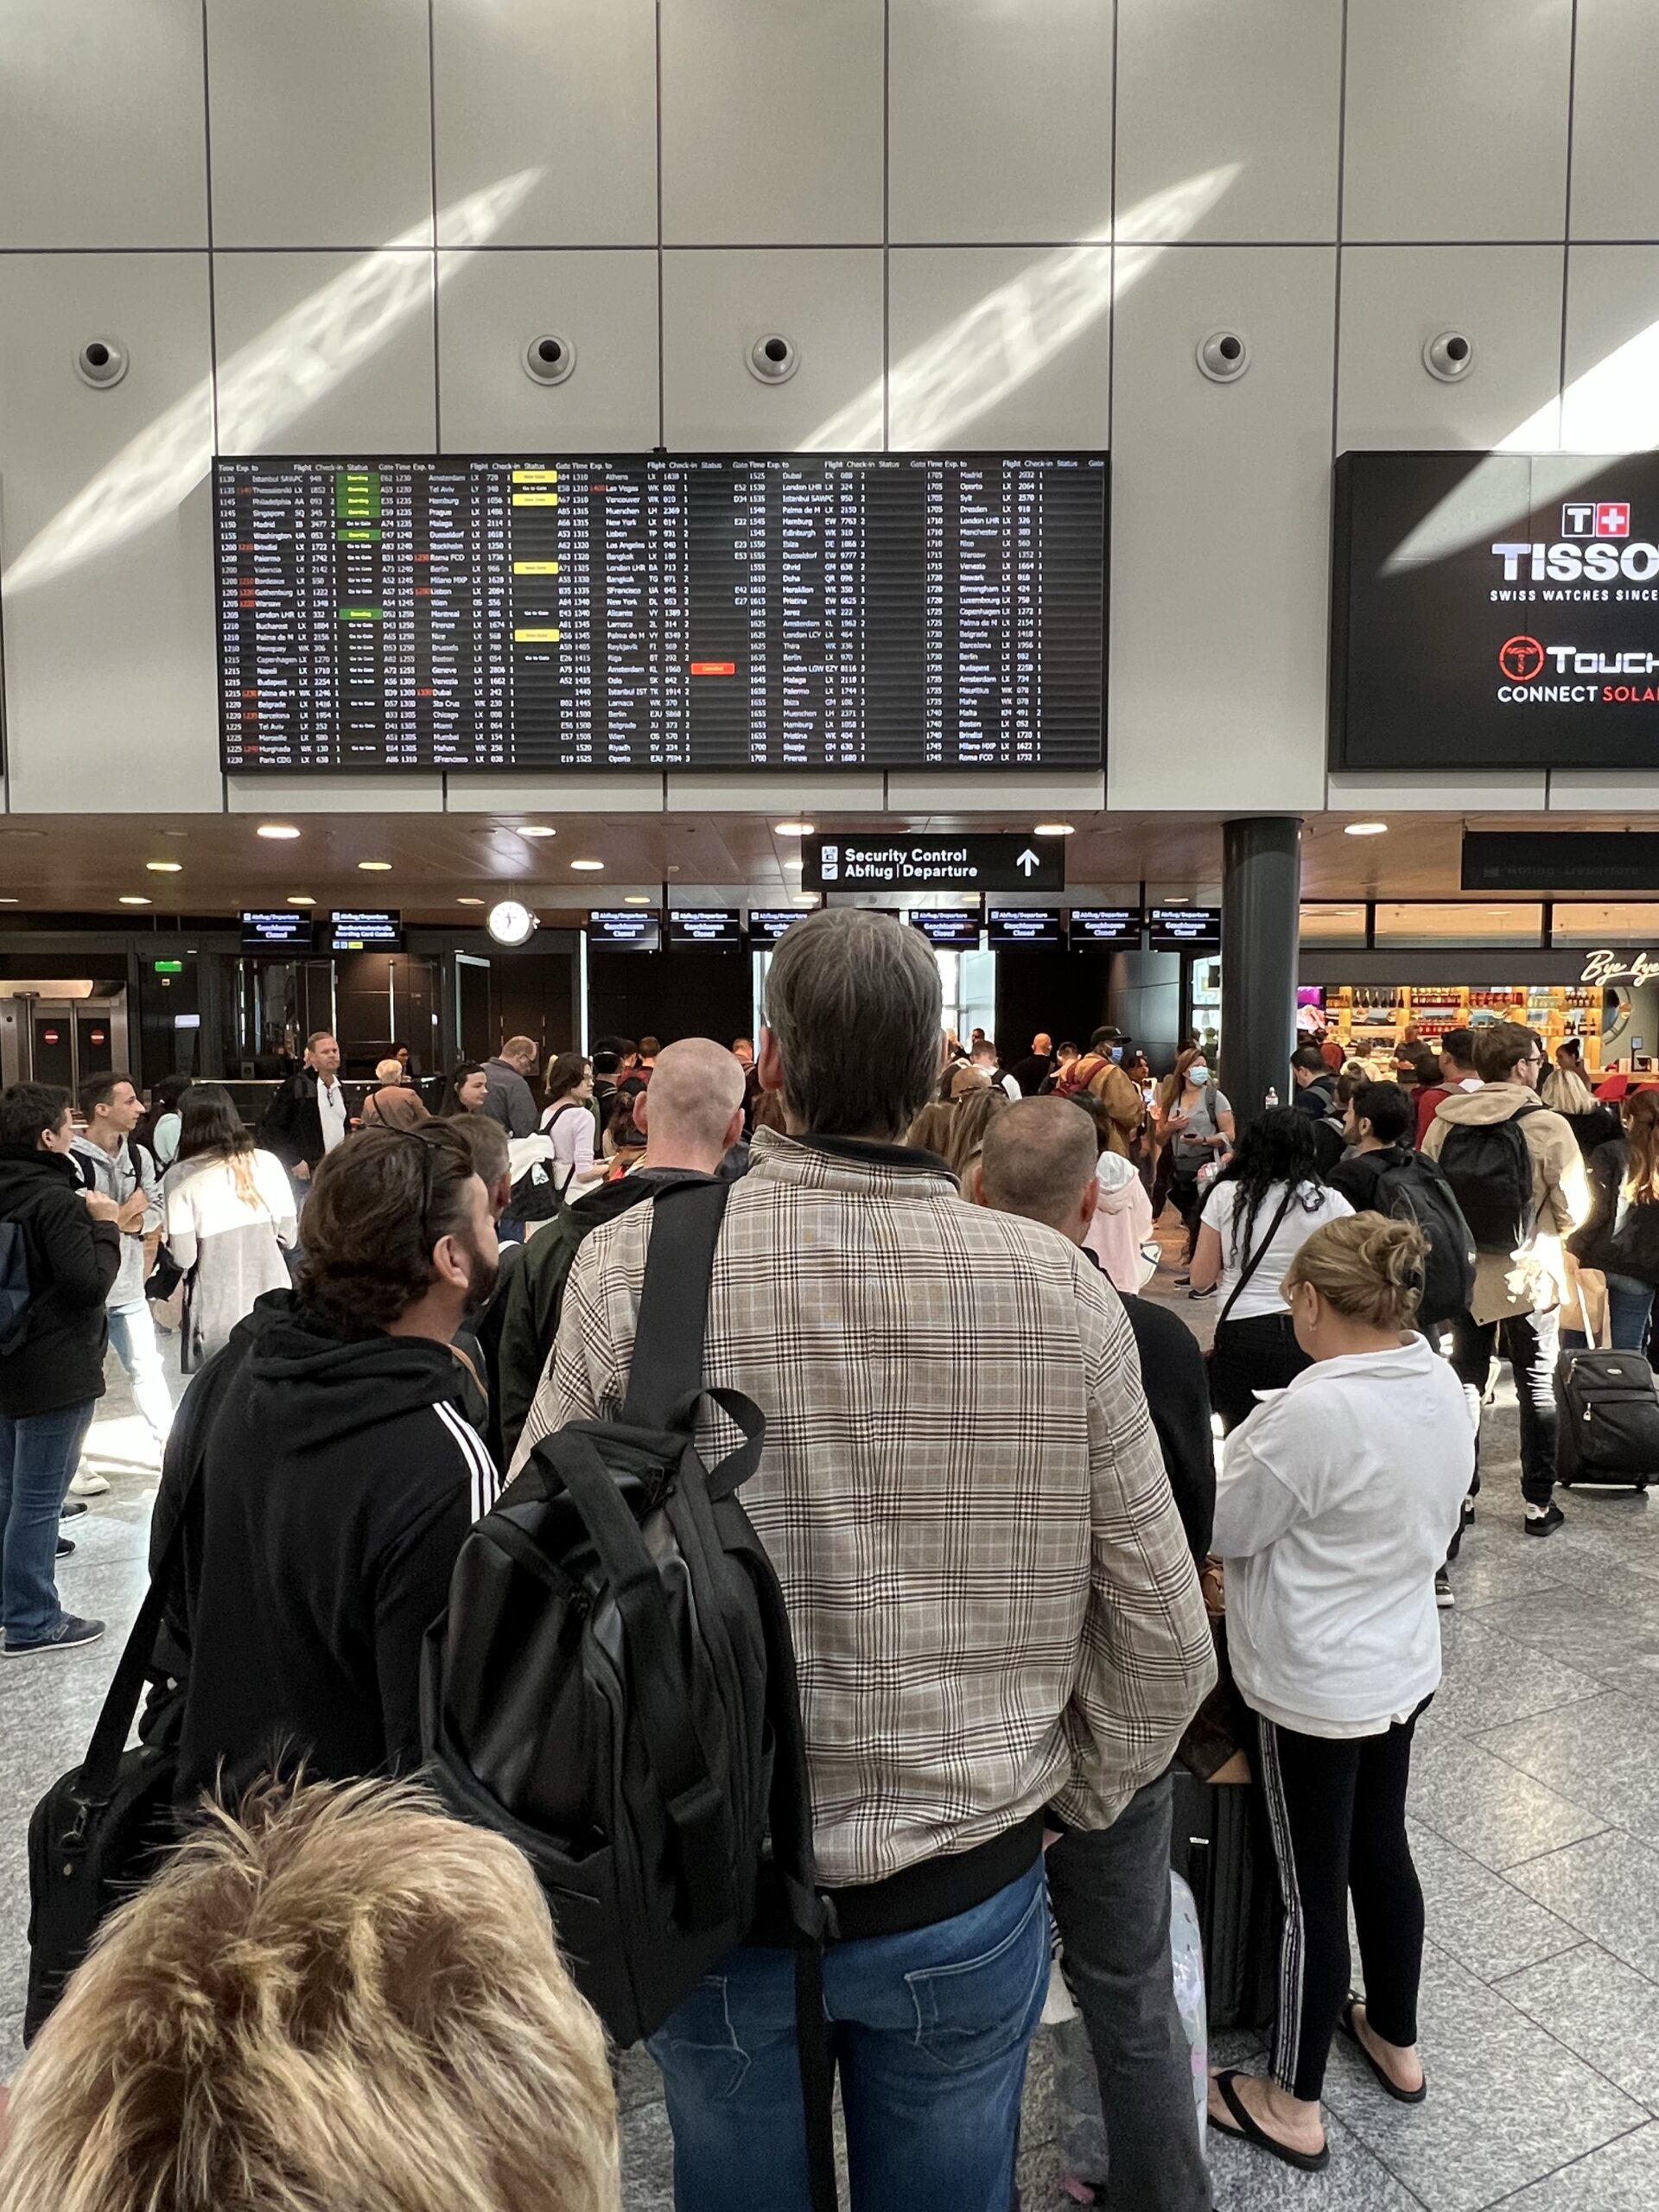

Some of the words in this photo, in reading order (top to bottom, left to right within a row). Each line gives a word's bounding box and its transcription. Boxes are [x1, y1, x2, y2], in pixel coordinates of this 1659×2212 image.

[294, 464, 312, 473] Flight
[470, 462, 488, 471] Flight
[524, 461, 545, 470] Status
[555, 461, 570, 470] Gate
[572, 461, 588, 470] Time
[647, 461, 665, 470] Flight
[733, 461, 748, 469] Gate
[825, 461, 842, 469] Flight
[910, 460, 925, 468] Gate
[1003, 460, 1020, 468] Flight
[1491, 543, 1659, 582] TISSO
[1490, 589, 1537, 601] SWISS
[1541, 589, 1609, 601] WATCHES
[1615, 589, 1659, 601] SINCE
[1497, 685, 1599, 703] CONNECT
[1602, 685, 1659, 702] SOLA
[844, 849, 907, 865] Security
[911, 848, 967, 862] Control
[844, 864, 893, 880] Abflug
[902, 864, 978, 880] Departure
[1580, 949, 1628, 987] Bye
